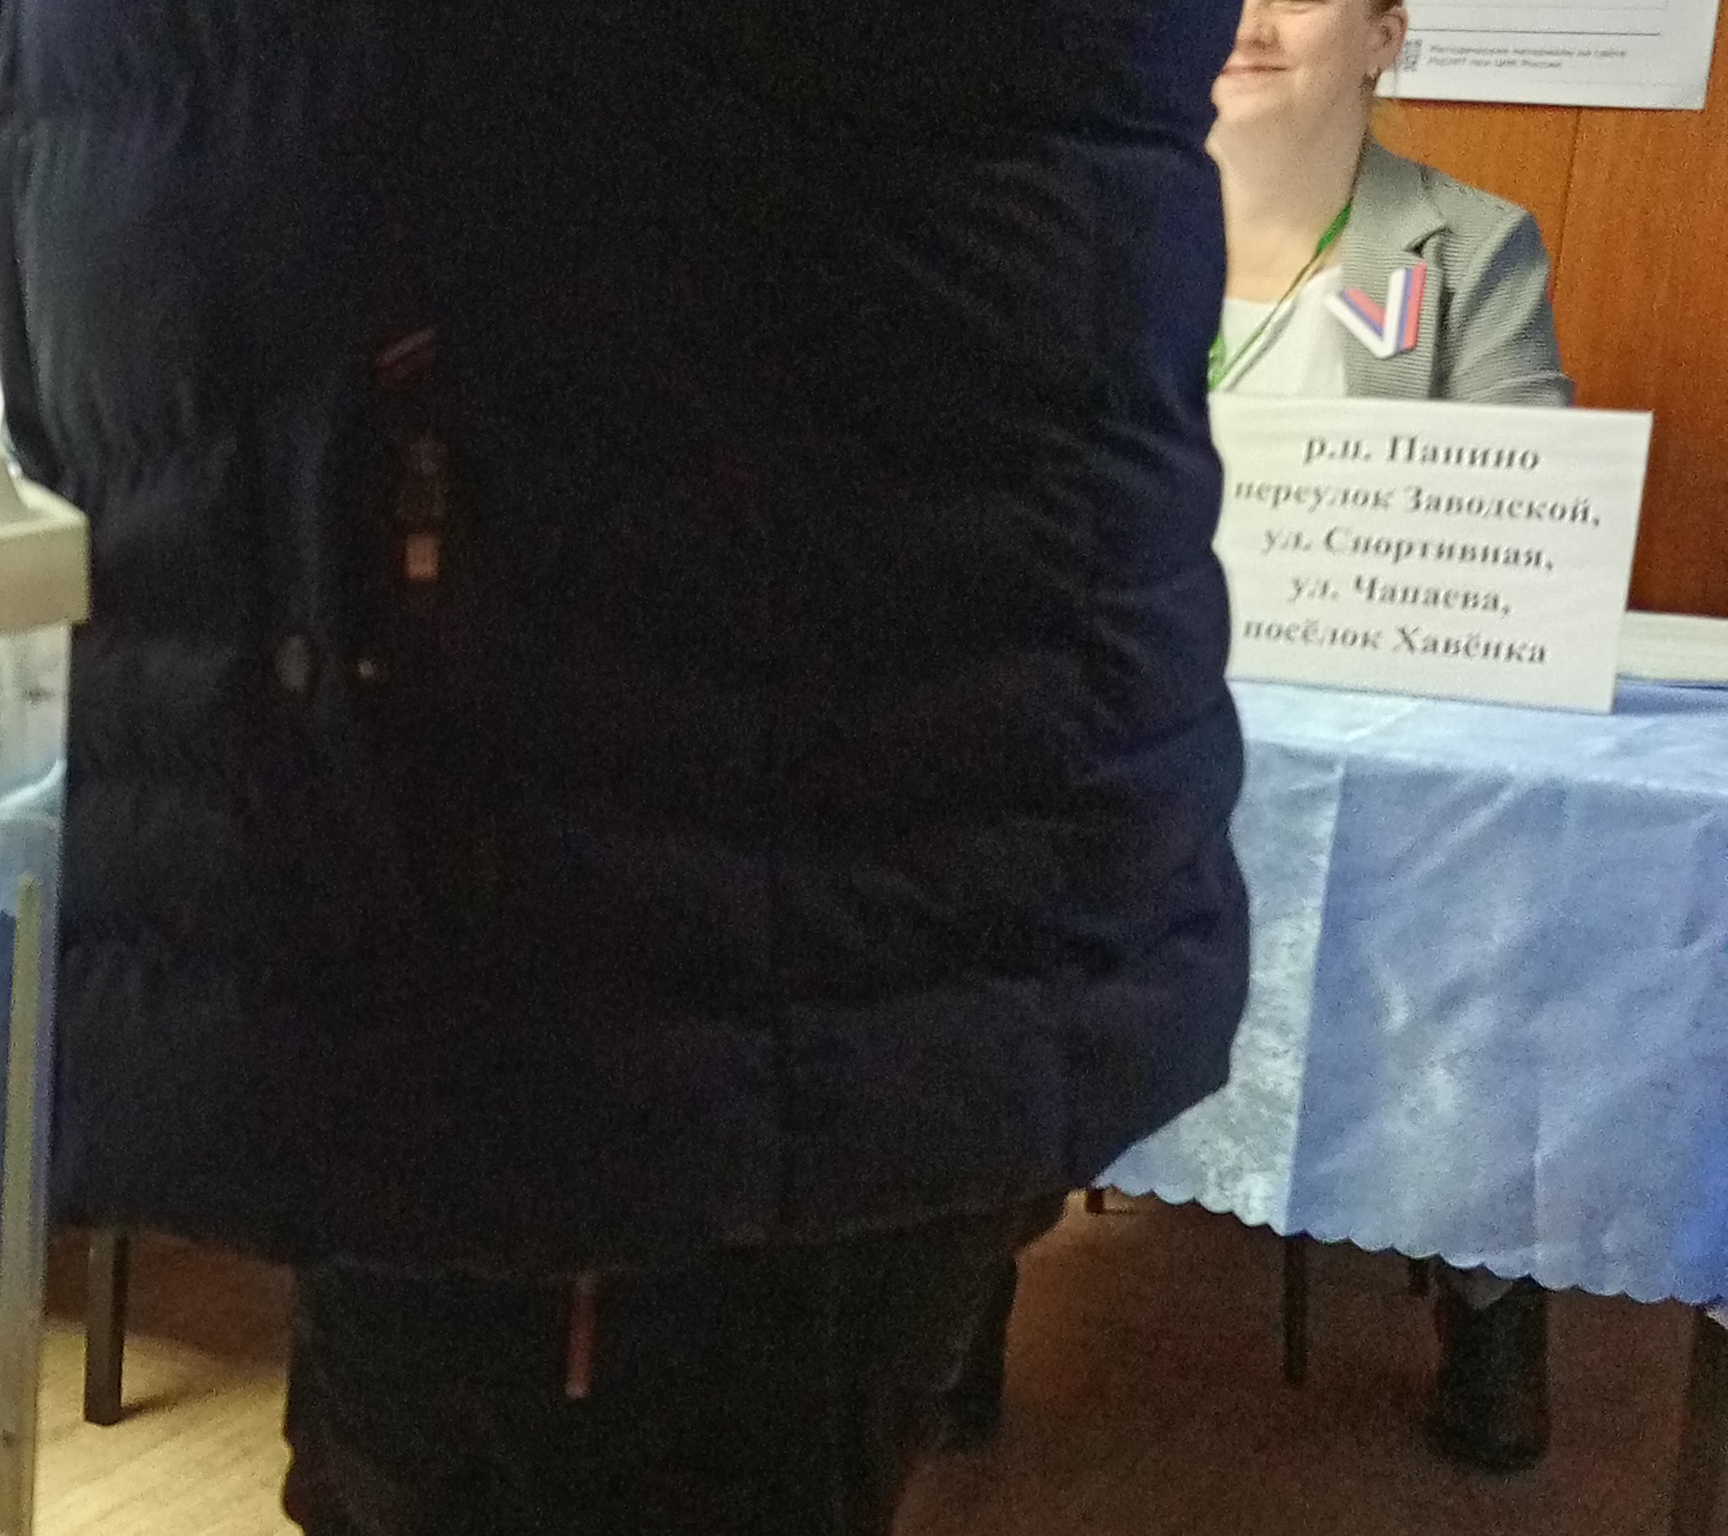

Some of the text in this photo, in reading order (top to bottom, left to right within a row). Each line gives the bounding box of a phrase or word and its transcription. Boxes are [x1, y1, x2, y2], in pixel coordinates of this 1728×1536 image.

[1303, 434, 1541, 472] р.п. Панино
[1234, 478, 1601, 528] переулок Заводской,
[1261, 525, 1555, 571] ул. Спортивная,
[1287, 573, 1512, 617] ул. Чапаева,
[1242, 618, 1548, 665] посёлок Хавёнка
